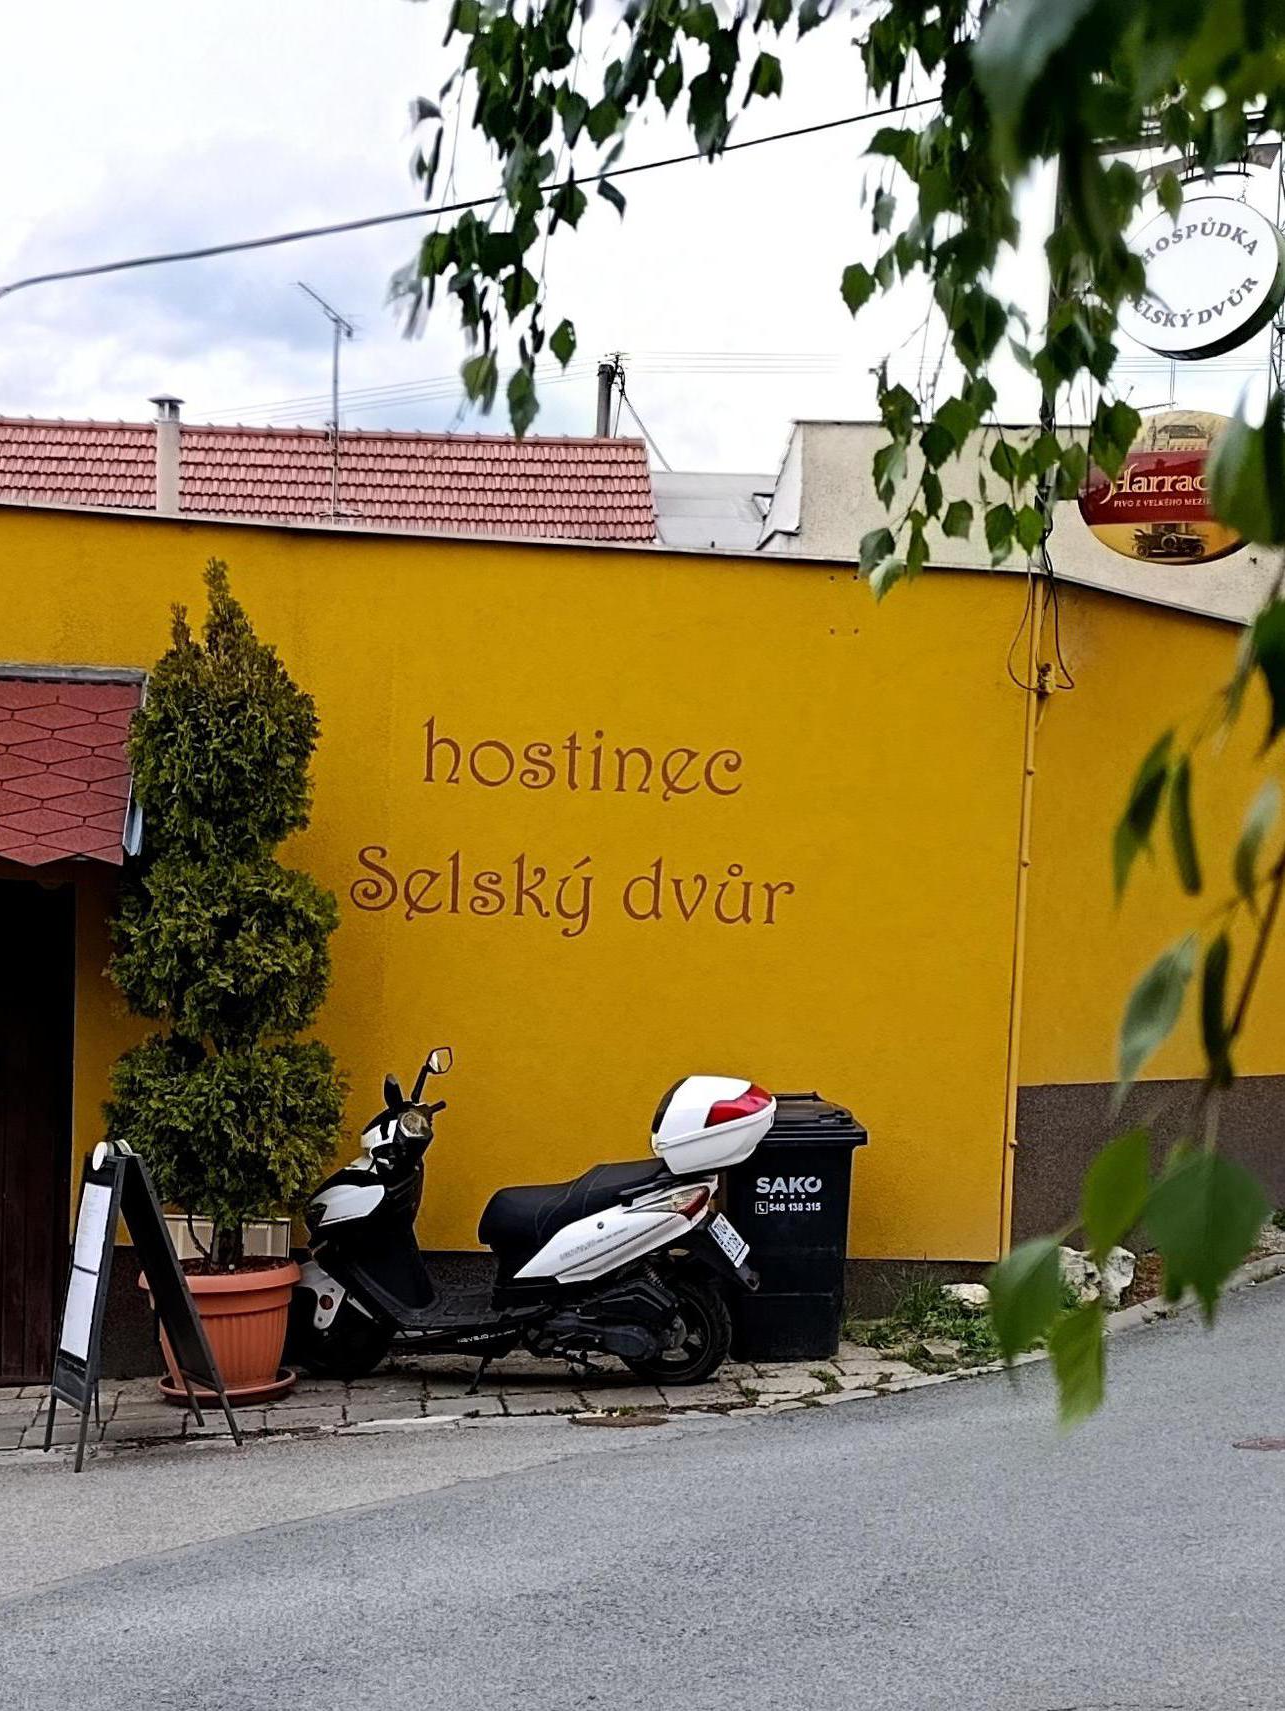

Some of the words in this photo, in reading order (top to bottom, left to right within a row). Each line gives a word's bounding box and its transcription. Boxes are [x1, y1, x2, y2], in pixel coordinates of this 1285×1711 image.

[1142, 217, 1259, 266] HOSPŮDKA
[1132, 298, 1192, 328] ELSKÝ
[1198, 276, 1259, 326] DVŮR
[1099, 463, 1211, 505] Harrac
[422, 715, 743, 802] hostinec
[349, 845, 593, 938] Selský
[622, 856, 796, 926] dvůr
[755, 1176, 822, 1194] SAKO
[769, 1202, 786, 1212] 548
[805, 1202, 822, 1212] 315
